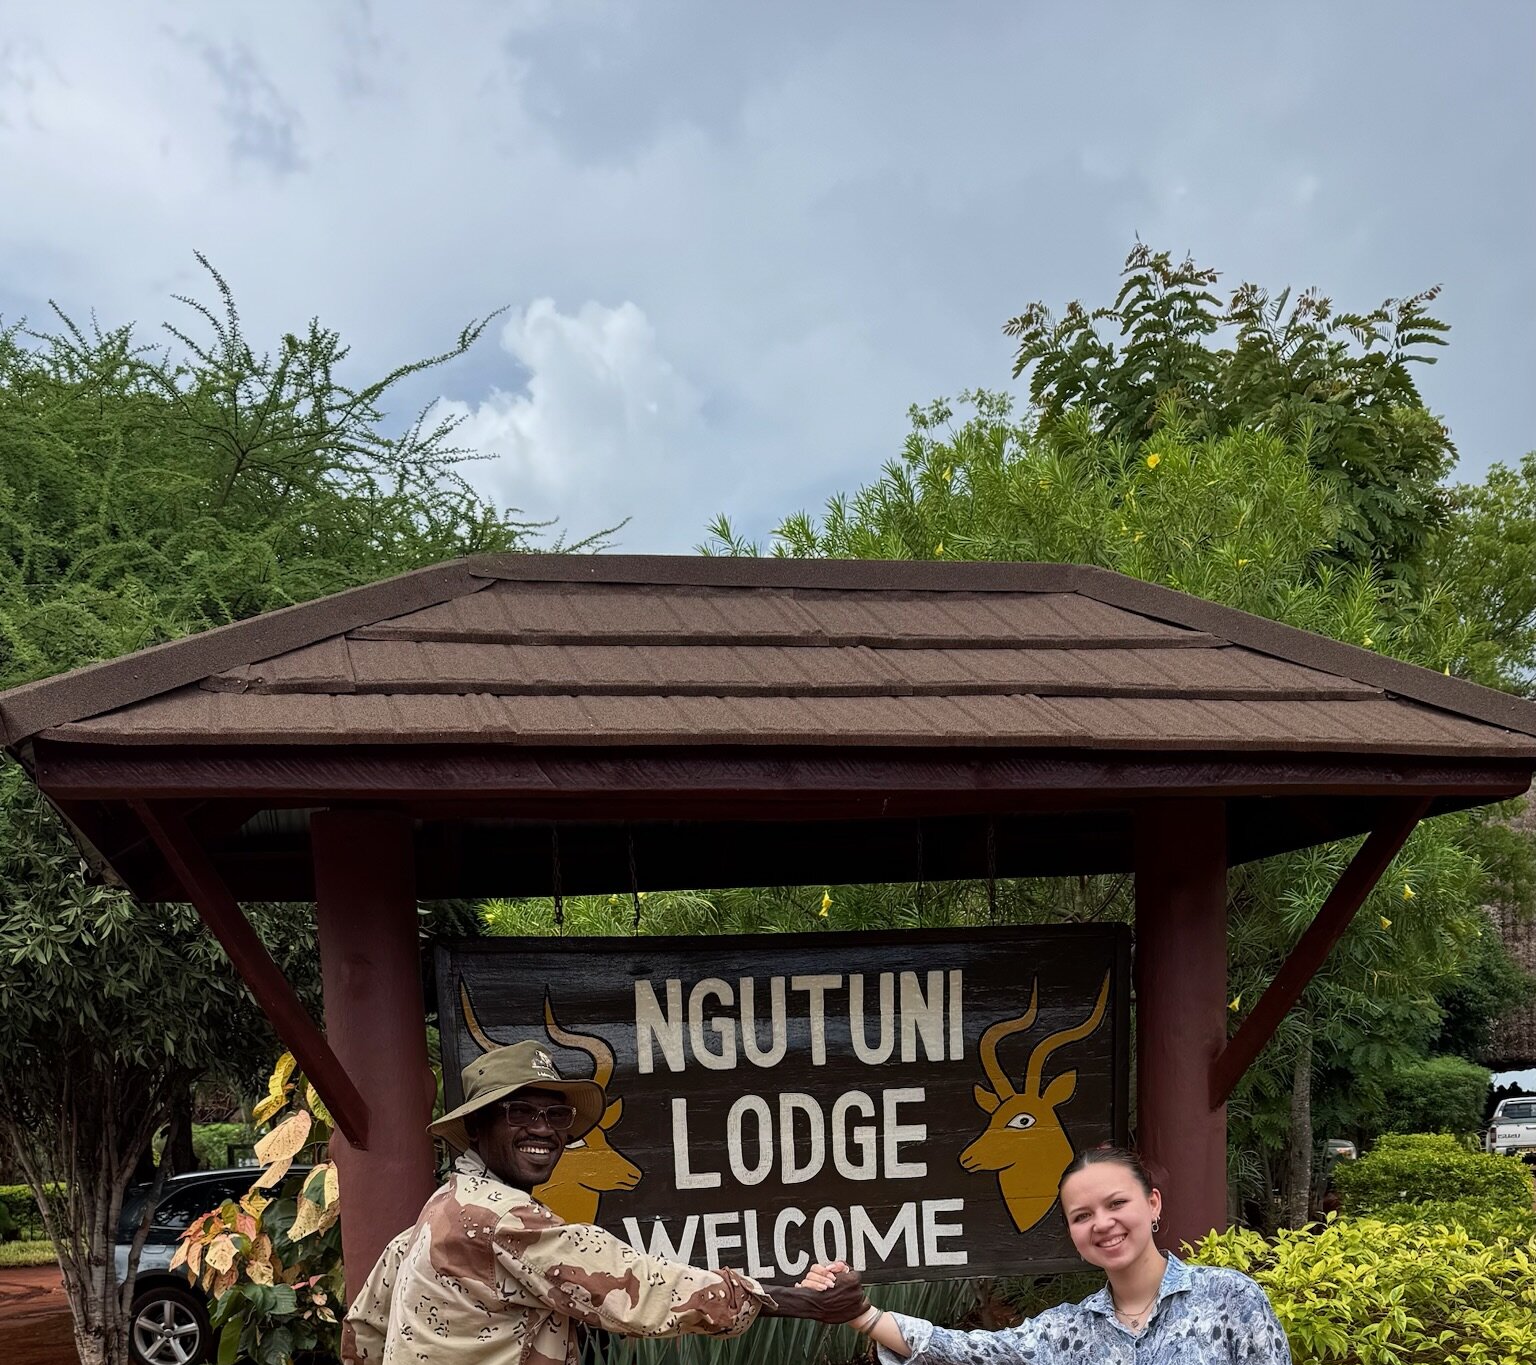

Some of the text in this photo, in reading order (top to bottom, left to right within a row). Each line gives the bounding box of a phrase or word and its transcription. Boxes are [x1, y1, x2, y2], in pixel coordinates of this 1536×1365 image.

[634, 969, 965, 1074] NGUTUNI
[671, 1087, 928, 1190] LODGE
[621, 1198, 968, 1279] WELCOME
